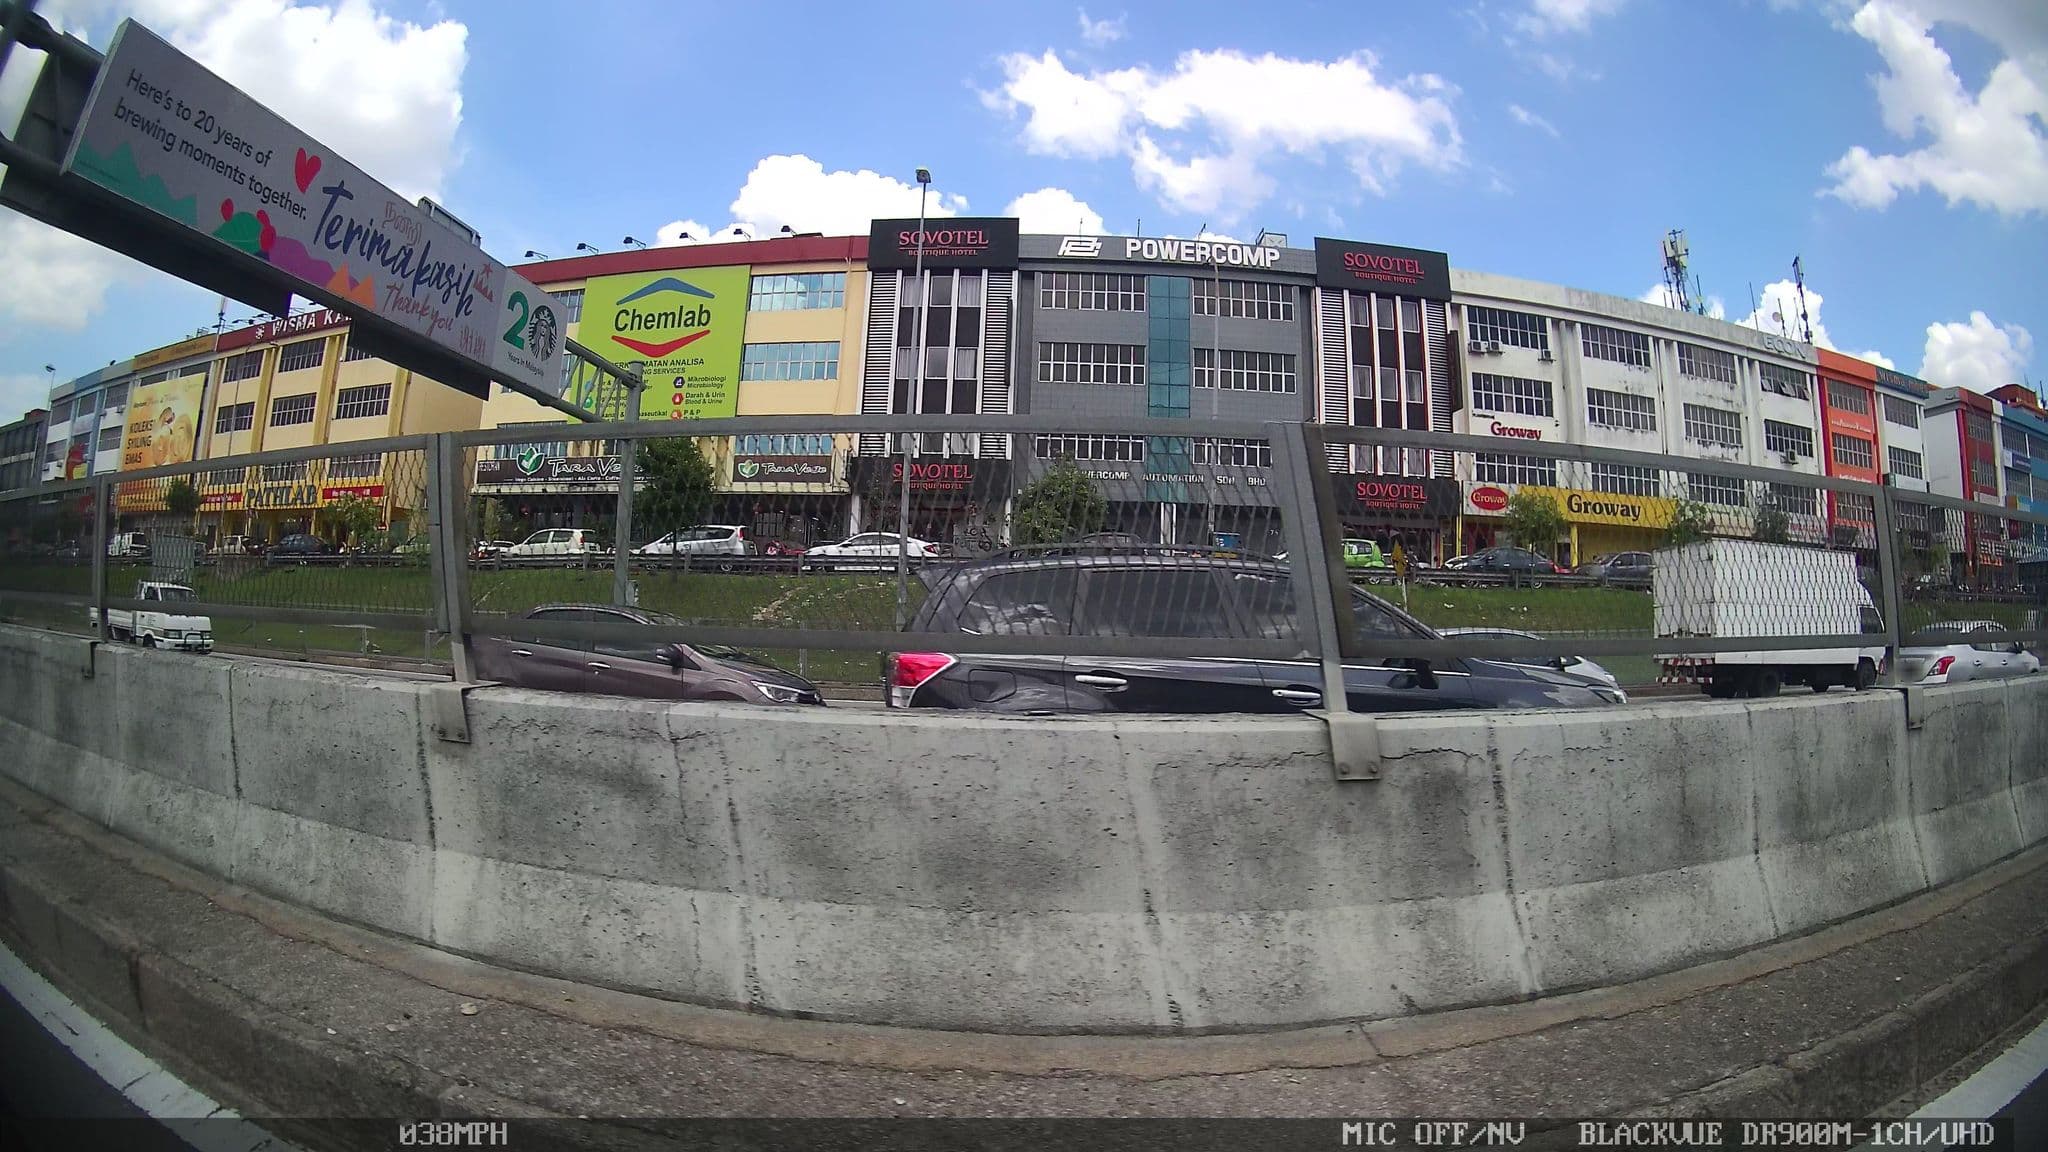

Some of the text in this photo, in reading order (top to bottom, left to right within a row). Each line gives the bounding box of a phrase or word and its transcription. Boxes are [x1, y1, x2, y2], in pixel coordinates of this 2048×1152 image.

[126, 68, 273, 167] Here's to 20 years of
[114, 97, 306, 220] brewing moments together.
[899, 230, 989, 246] SOVOTEL
[1126, 238, 1280, 268] POWERCOMP
[1344, 252, 1424, 274] SOVOTEL
[1355, 271, 1417, 284] BOUTIQUE HOTEL
[382, 282, 454, 336] Thank you
[614, 304, 711, 332] Chemlab
[272, 313, 316, 336] WISMA
[670, 358, 704, 367] ANALISA
[1490, 421, 1542, 441] Groway
[1142, 473, 1204, 484] AUTOMATION
[1216, 475, 1235, 485] SDN
[1357, 481, 1428, 499] SOVOTEL
[246, 485, 317, 508] PATHLAB
[1471, 491, 1508, 506] Groway
[1567, 493, 1641, 522] Groway
